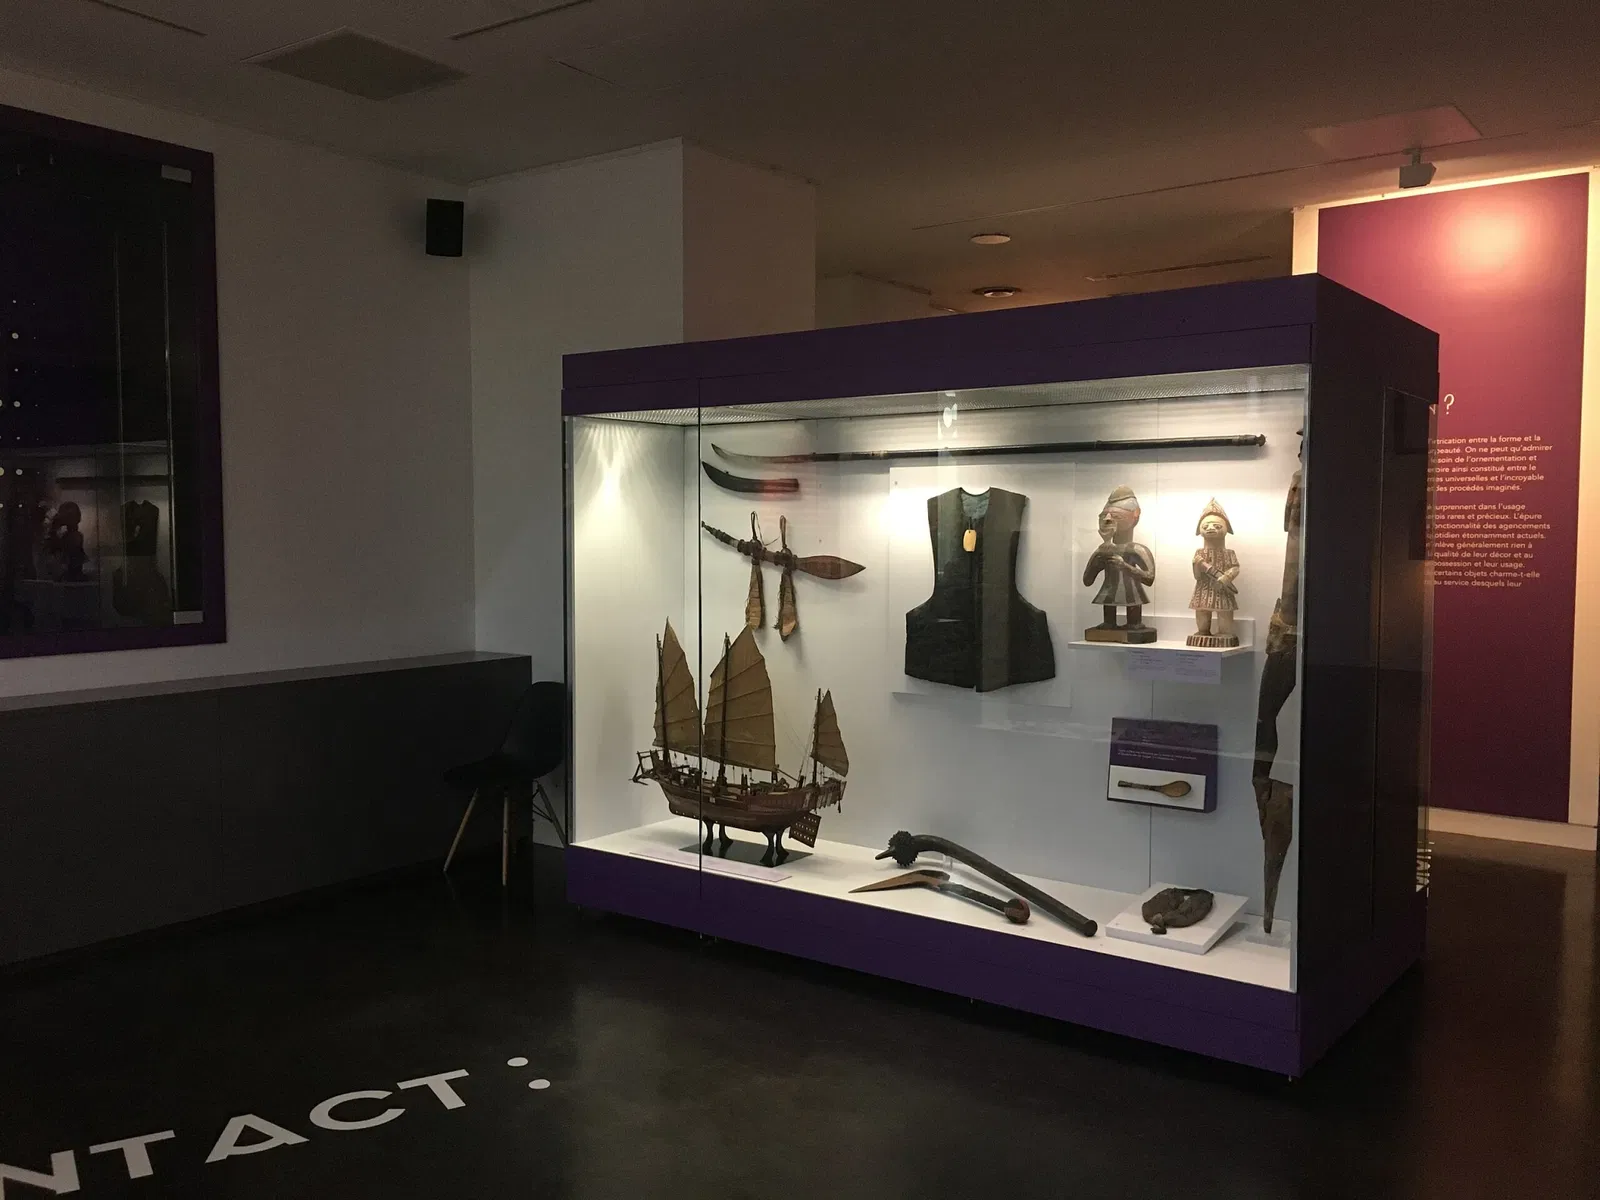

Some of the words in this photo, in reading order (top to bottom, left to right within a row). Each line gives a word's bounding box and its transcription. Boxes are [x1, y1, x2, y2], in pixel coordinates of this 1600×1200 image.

[1443, 393, 1455, 415] ?
[1468, 436, 1488, 444] entre
[1499, 435, 1521, 443] forme
[1490, 446, 1509, 456] peut
[1510, 445, 1553, 456] qu'admirer
[1455, 455, 1465, 463] de
[1452, 465, 1468, 473] ainsi
[1470, 464, 1505, 473] constitué
[1507, 464, 1527, 472] entre
[1445, 475, 1488, 483] universelles
[1435, 504, 1476, 512] urprennent
[1478, 502, 1497, 510] dans
[1483, 522, 1497, 530] des
[1499, 523, 1551, 531] agencements
[1483, 560, 1498, 568] leur
[1464, 569, 1488, 578] objets
[1443, 579, 1469, 587] service
[1471, 579, 1505, 589] desquels
[1506, 580, 1522, 588] leur
